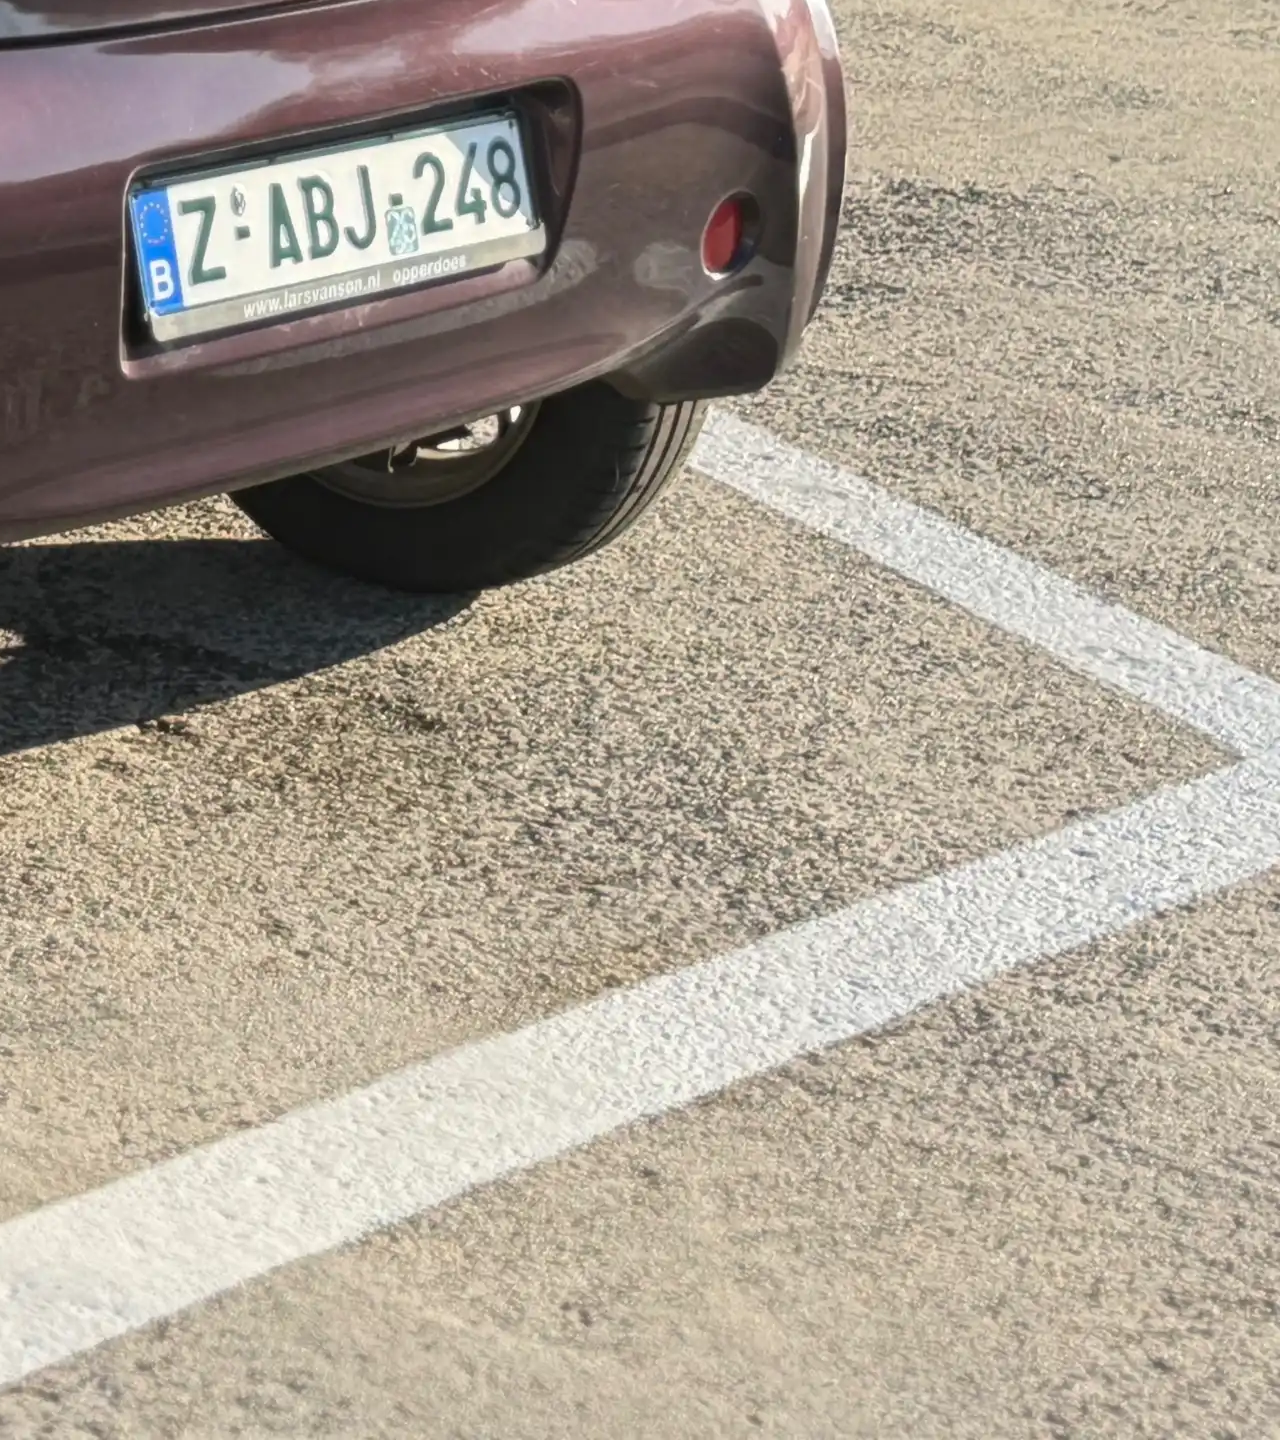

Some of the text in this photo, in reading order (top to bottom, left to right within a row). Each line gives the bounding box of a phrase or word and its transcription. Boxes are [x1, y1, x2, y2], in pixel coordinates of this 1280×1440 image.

[148, 258, 176, 302] B
[243, 253, 468, 319] www.larsvanson.nl opperdoes
